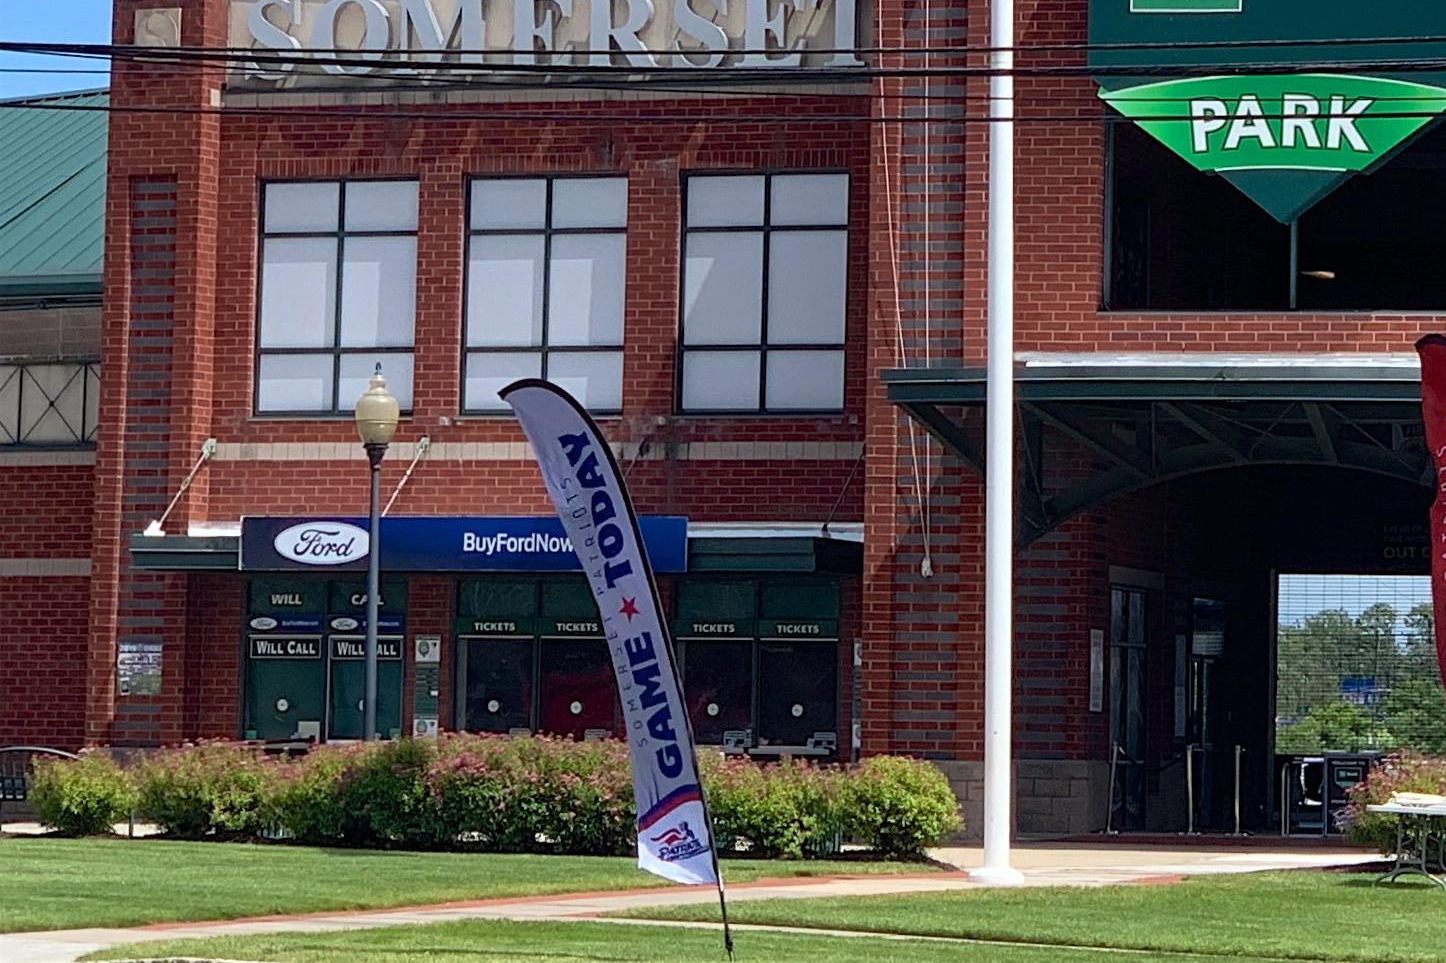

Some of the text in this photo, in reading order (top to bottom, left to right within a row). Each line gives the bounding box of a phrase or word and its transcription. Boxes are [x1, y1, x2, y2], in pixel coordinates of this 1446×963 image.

[1188, 92, 1375, 154] PARK
[294, 529, 356, 557] Ford
[271, 594, 384, 605] WILL CAL
[558, 431, 683, 778] GAME TODAY
[560, 477, 648, 748] SOMERSET PATRIOTS
[474, 622, 516, 632] TICKETS
[556, 622, 599, 632] TICKETS
[693, 623, 736, 633] TICKETS
[777, 624, 820, 634] TICKETS
[256, 641, 316, 655] WILL CALL
[337, 641, 397, 656] WILL ALL
